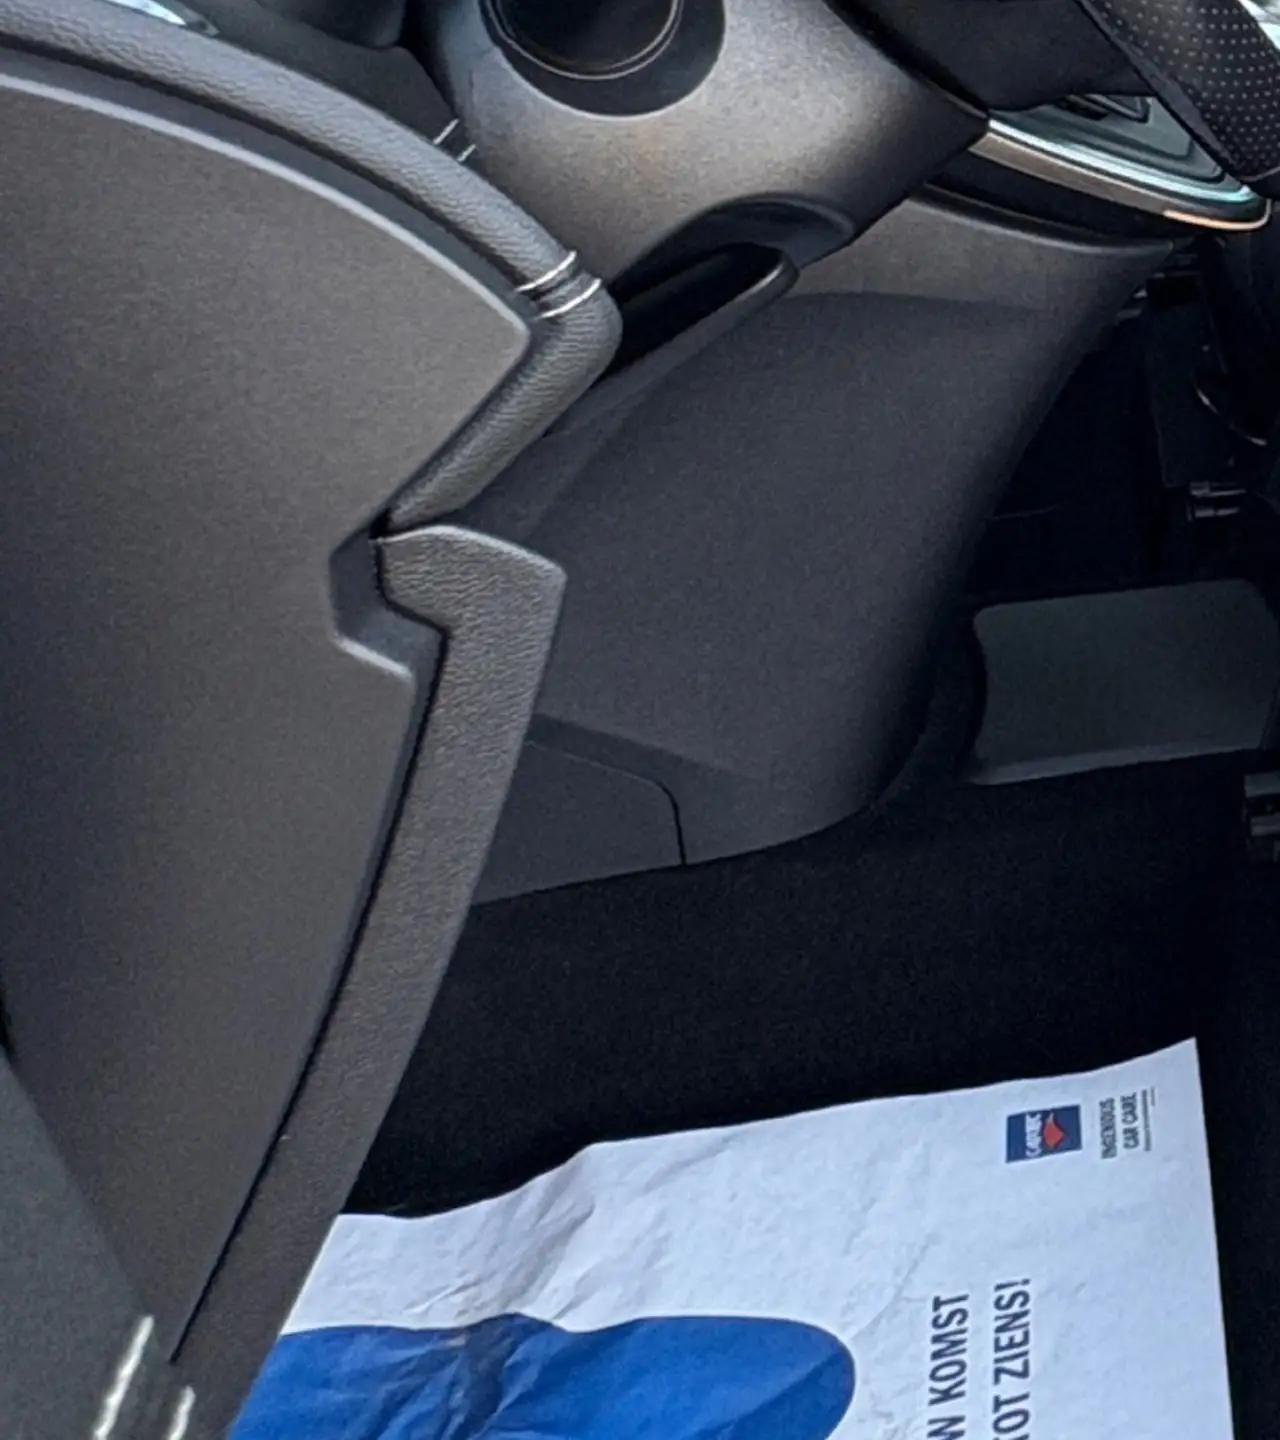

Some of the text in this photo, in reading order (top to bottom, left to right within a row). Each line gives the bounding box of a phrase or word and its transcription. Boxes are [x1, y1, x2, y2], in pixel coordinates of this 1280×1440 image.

[1120, 1092, 1140, 1149] CAR CARE
[929, 1295, 969, 1406] KOMST
[993, 1279, 1031, 1386] ZIENS!
